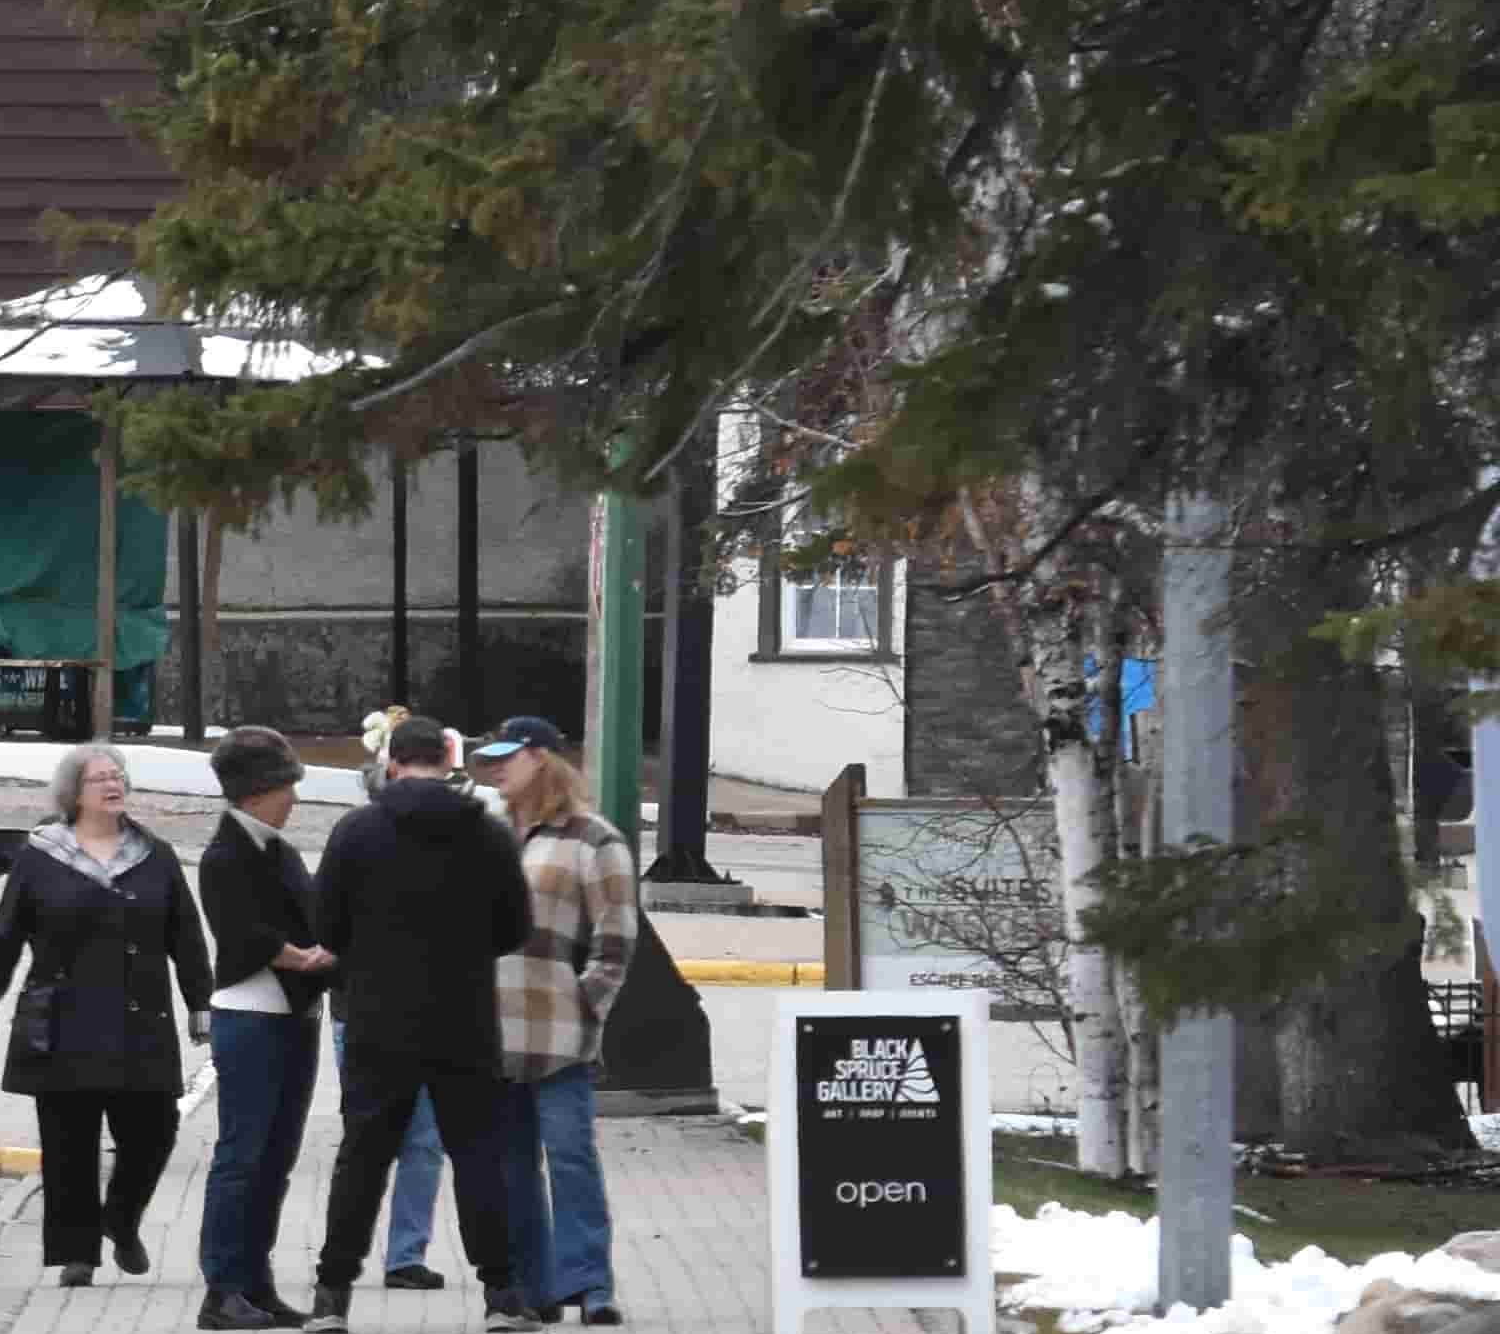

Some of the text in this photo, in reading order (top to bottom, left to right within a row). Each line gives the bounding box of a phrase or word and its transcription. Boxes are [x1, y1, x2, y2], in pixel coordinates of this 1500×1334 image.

[852, 1039, 908, 1059] BLACK
[835, 1059, 904, 1080] SPRUCE
[817, 1081, 896, 1102] GALLERY
[836, 1181, 927, 1208] open
